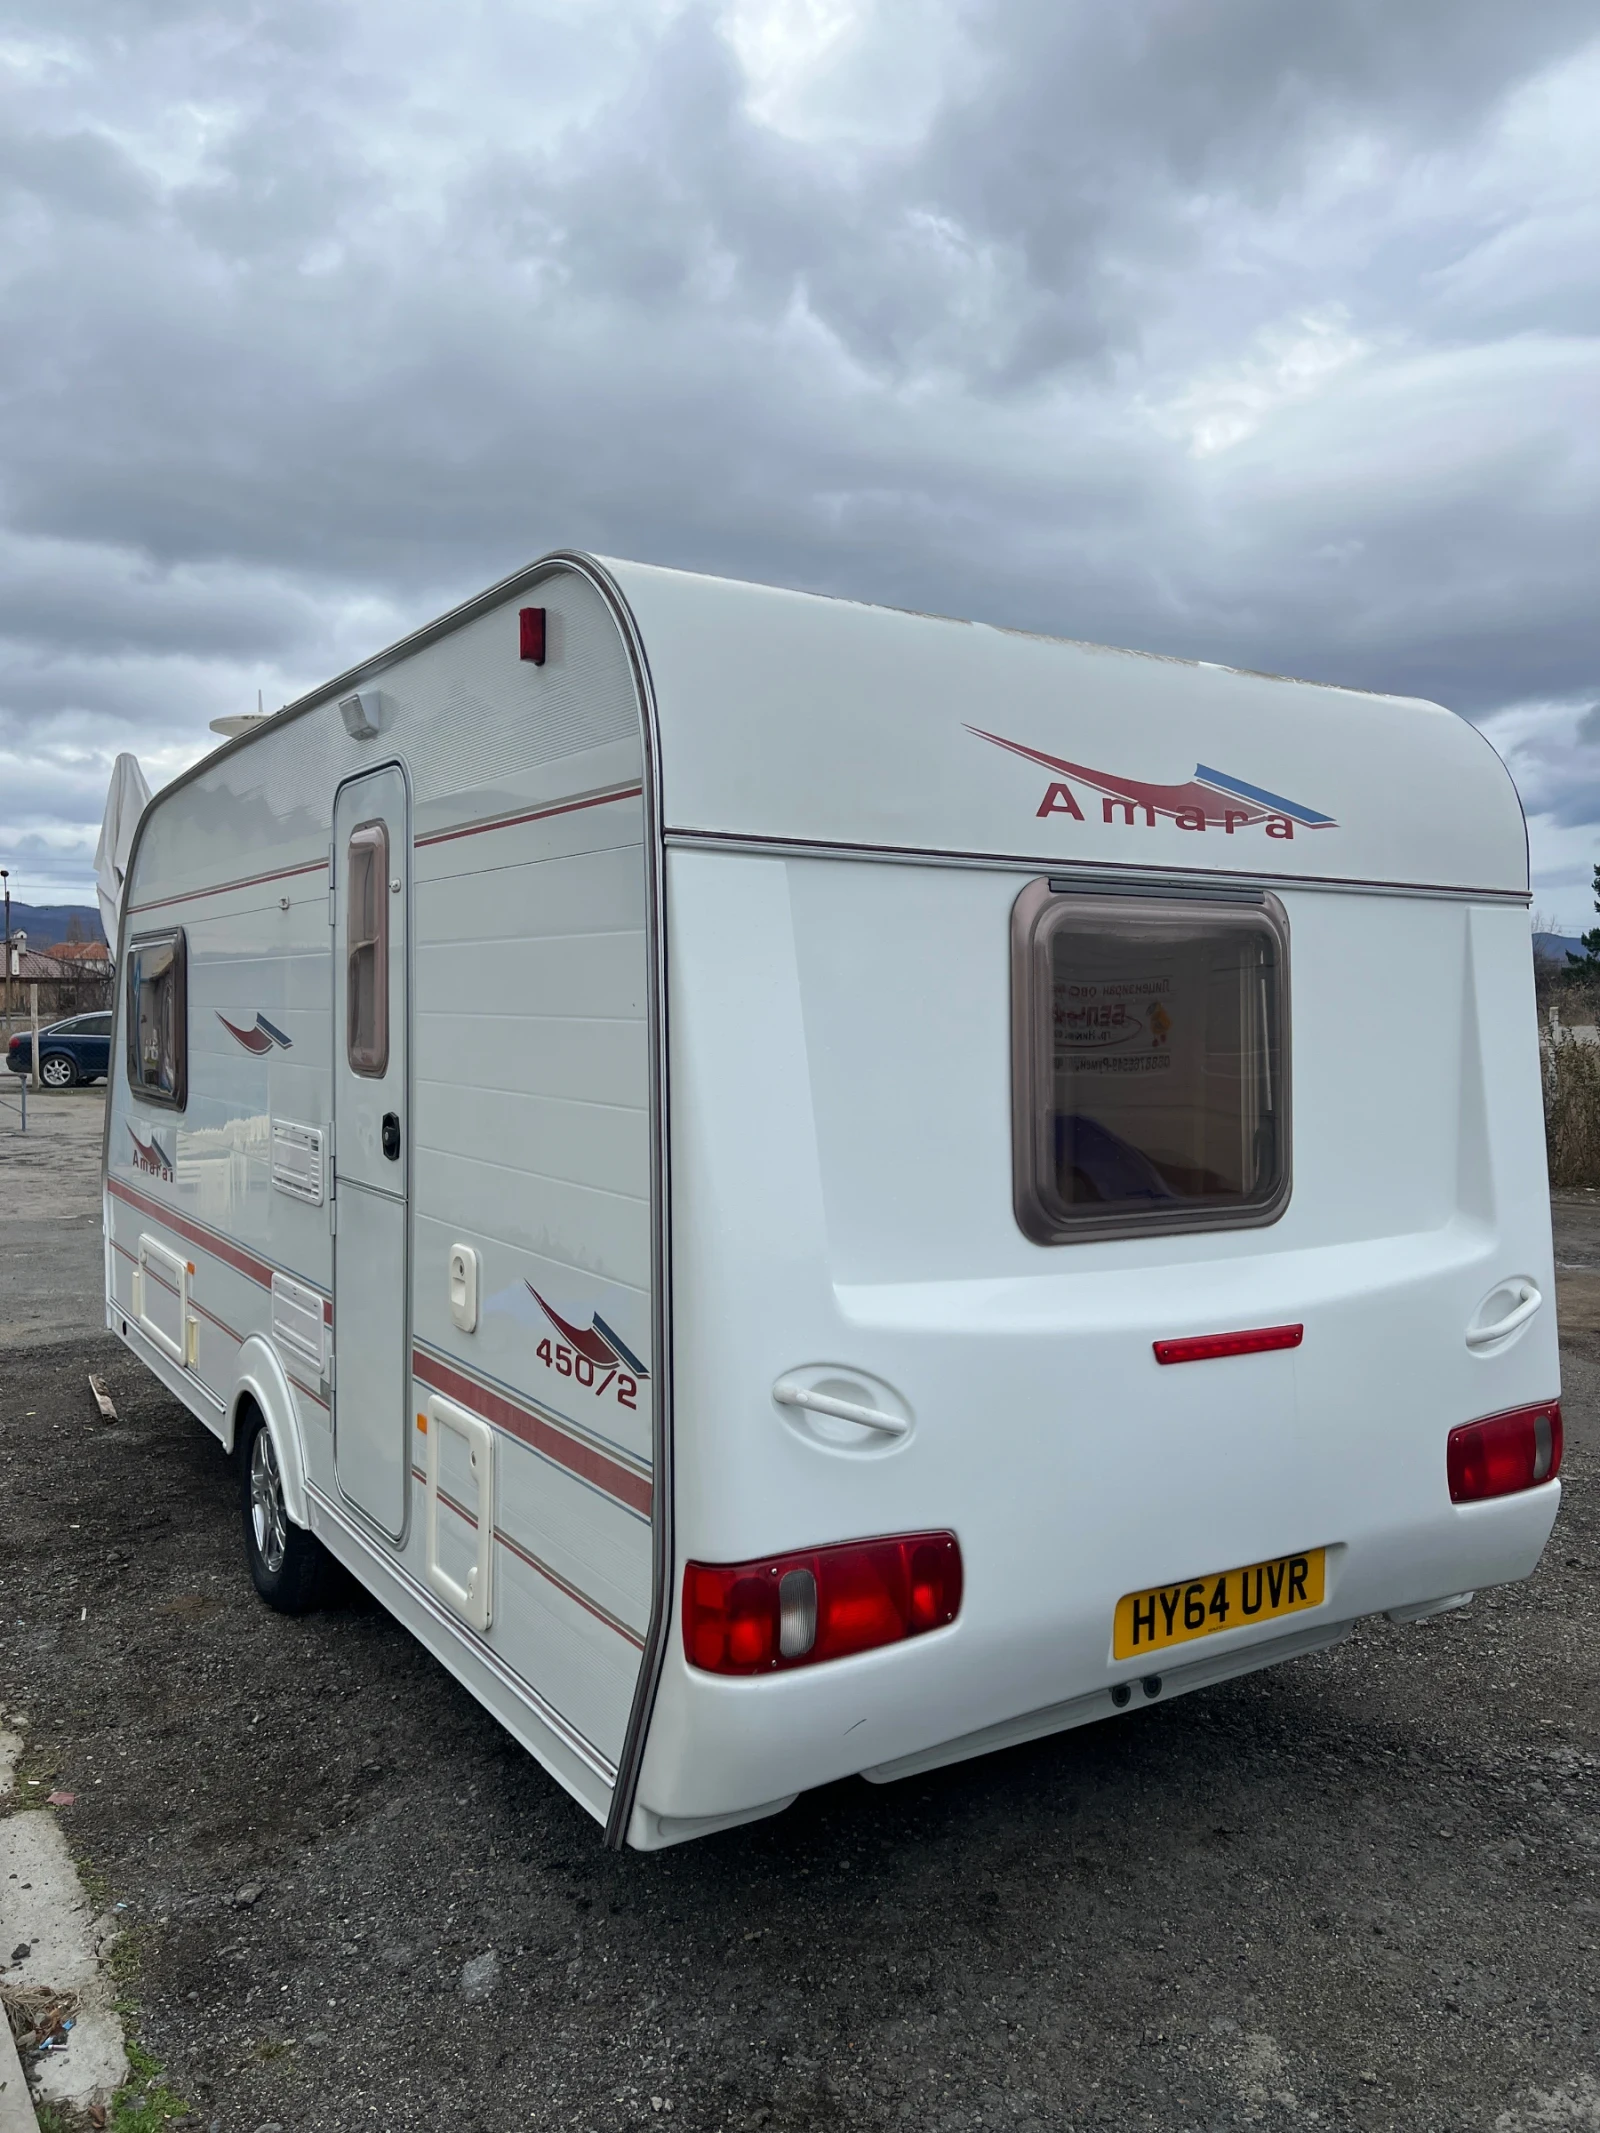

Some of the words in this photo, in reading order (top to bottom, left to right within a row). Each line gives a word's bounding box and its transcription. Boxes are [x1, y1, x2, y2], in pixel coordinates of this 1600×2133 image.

[1035, 782, 1294, 840] Amara
[536, 1338, 637, 1411] 450/2
[1132, 1577, 1230, 1646] HY64
[1242, 1557, 1309, 1616] UVR
